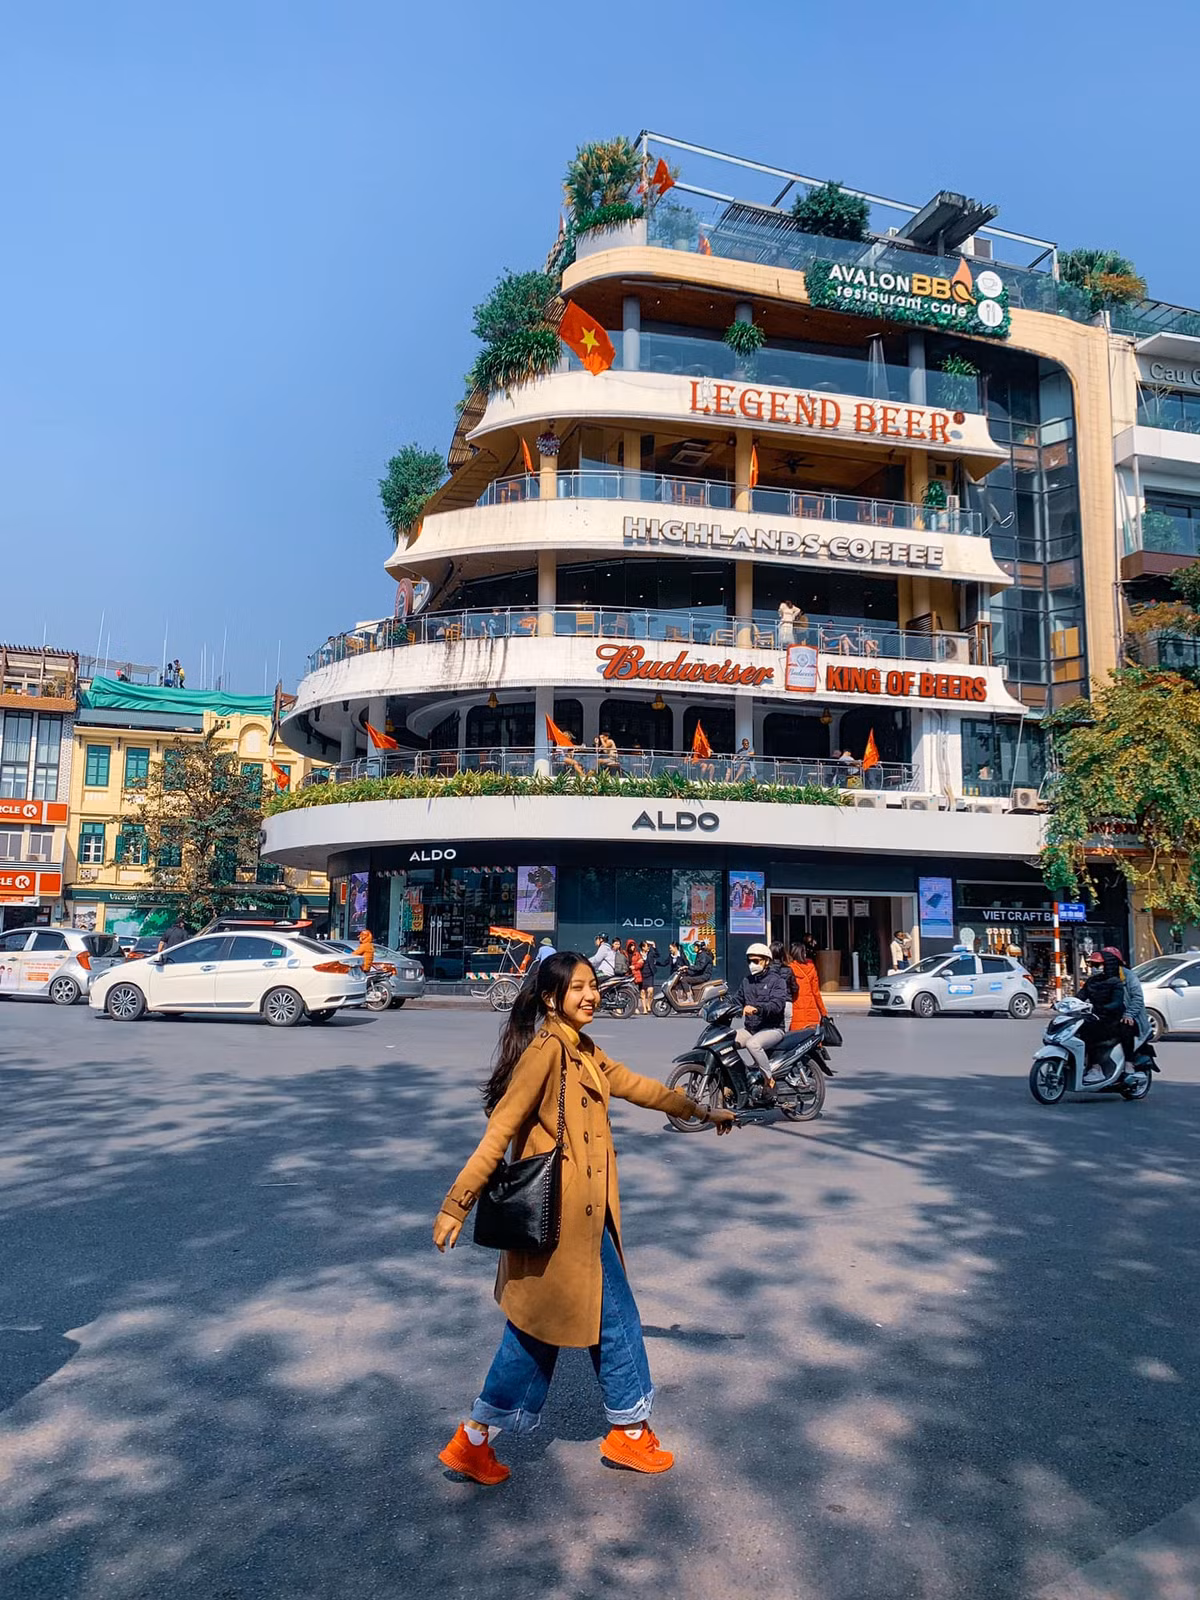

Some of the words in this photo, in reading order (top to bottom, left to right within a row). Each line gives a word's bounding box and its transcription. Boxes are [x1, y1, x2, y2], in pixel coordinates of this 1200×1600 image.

[828, 264, 910, 293] AVALON
[912, 264, 977, 305] BBQ
[837, 285, 922, 310] restaurant
[931, 302, 968, 318] cafe
[1150, 362, 1187, 384] Cau
[690, 380, 841, 428] LEGEND
[854, 402, 951, 444] BEER
[623, 516, 821, 555] HIGHLANDS
[829, 537, 944, 566] COFFEE
[596, 643, 775, 685] Budweiser
[826, 665, 881, 694] KING
[886, 670, 916, 696] OF
[919, 672, 987, 702] BEERS
[26, 806, 37, 817] K
[632, 810, 720, 832] ALDO
[409, 849, 457, 862] ALDO
[17, 877, 29, 888] K
[622, 918, 665, 928] ALDO
[982, 910, 1007, 921] VIET
[1007, 911, 1042, 922] CRAFT
